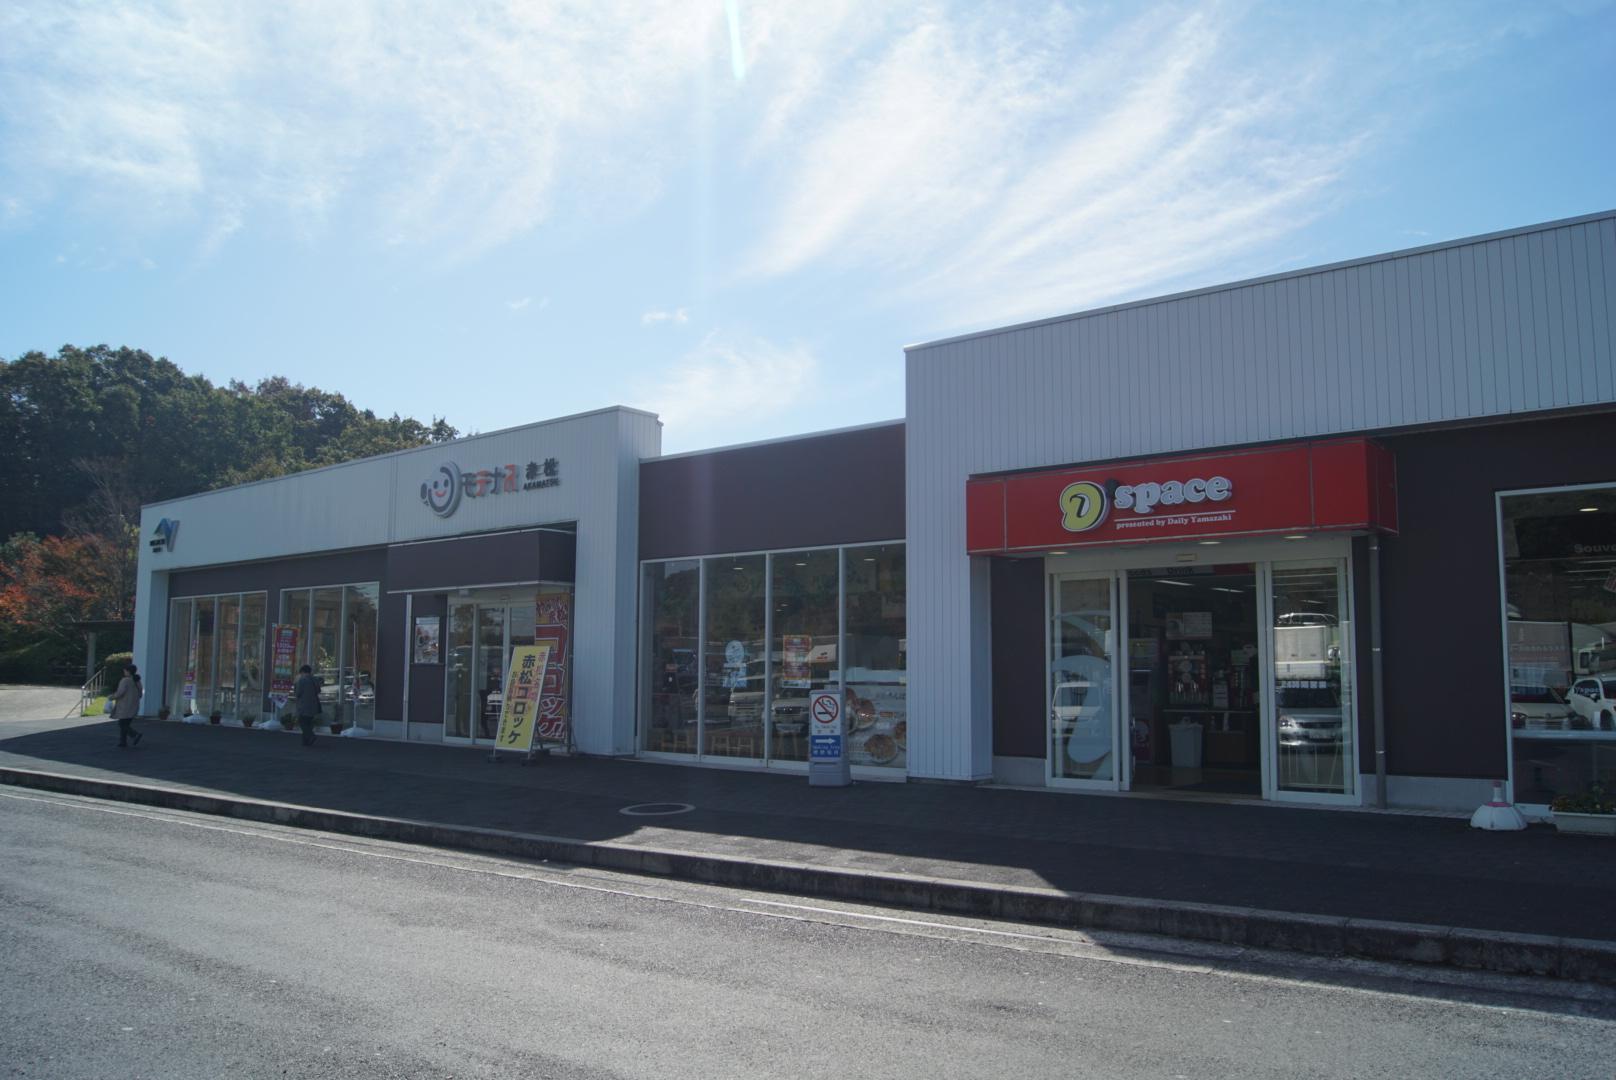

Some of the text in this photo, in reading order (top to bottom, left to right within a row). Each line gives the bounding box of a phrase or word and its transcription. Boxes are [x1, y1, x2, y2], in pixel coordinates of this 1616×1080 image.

[1115, 514, 1232, 530] presented by Daily Yamazaki
[508, 654, 536, 744] 赤松コロッケ
